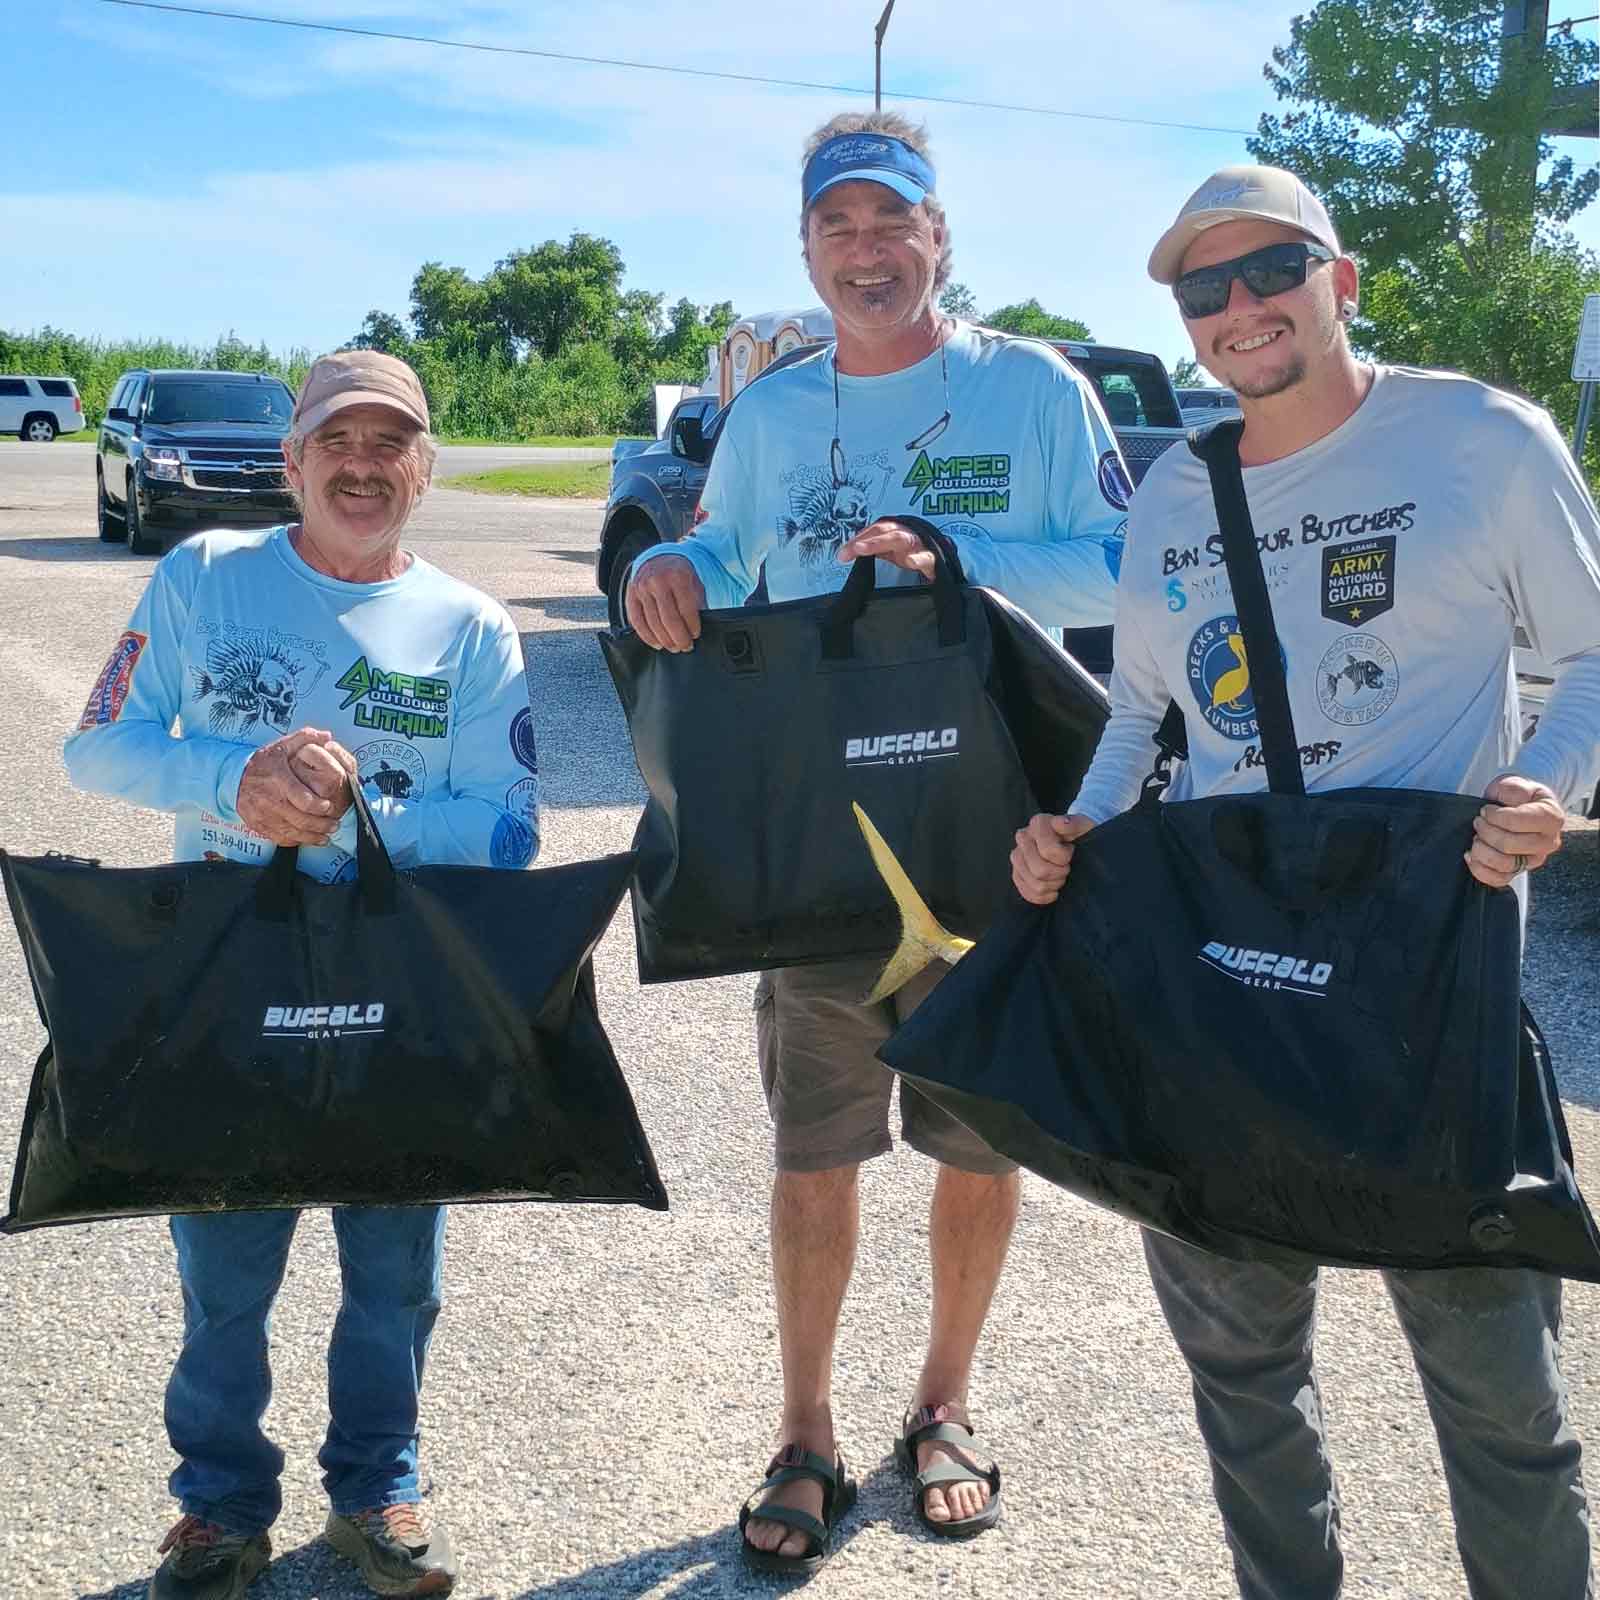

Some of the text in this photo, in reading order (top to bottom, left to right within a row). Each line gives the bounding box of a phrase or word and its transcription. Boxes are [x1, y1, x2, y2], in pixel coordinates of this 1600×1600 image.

[932, 476, 1010, 489] OUTDOORS
[922, 489, 1010, 518] LITHIUM
[1206, 527, 1293, 567] SOUR
[1301, 502, 1416, 544] BUTCHERS
[1340, 542, 1377, 554] ALABAMA
[1329, 554, 1387, 577] ARMY
[1328, 570, 1387, 588] NATIONAL
[1328, 582, 1386, 603] GUARD
[1190, 621, 1229, 678] DECKS &
[369, 690, 449, 712] OUTDOORS
[354, 702, 449, 740] LITHIUM
[1204, 705, 1259, 736] LUMBER
[355, 743, 415, 762] OOKED
[845, 727, 958, 759] BUFFALO
[888, 754, 923, 765] GEAR
[1201, 941, 1333, 985] BUFFALO
[1243, 976, 1281, 991] GEAR
[263, 1002, 385, 1028] BUFFALO
[307, 1029, 341, 1039] GEAR
